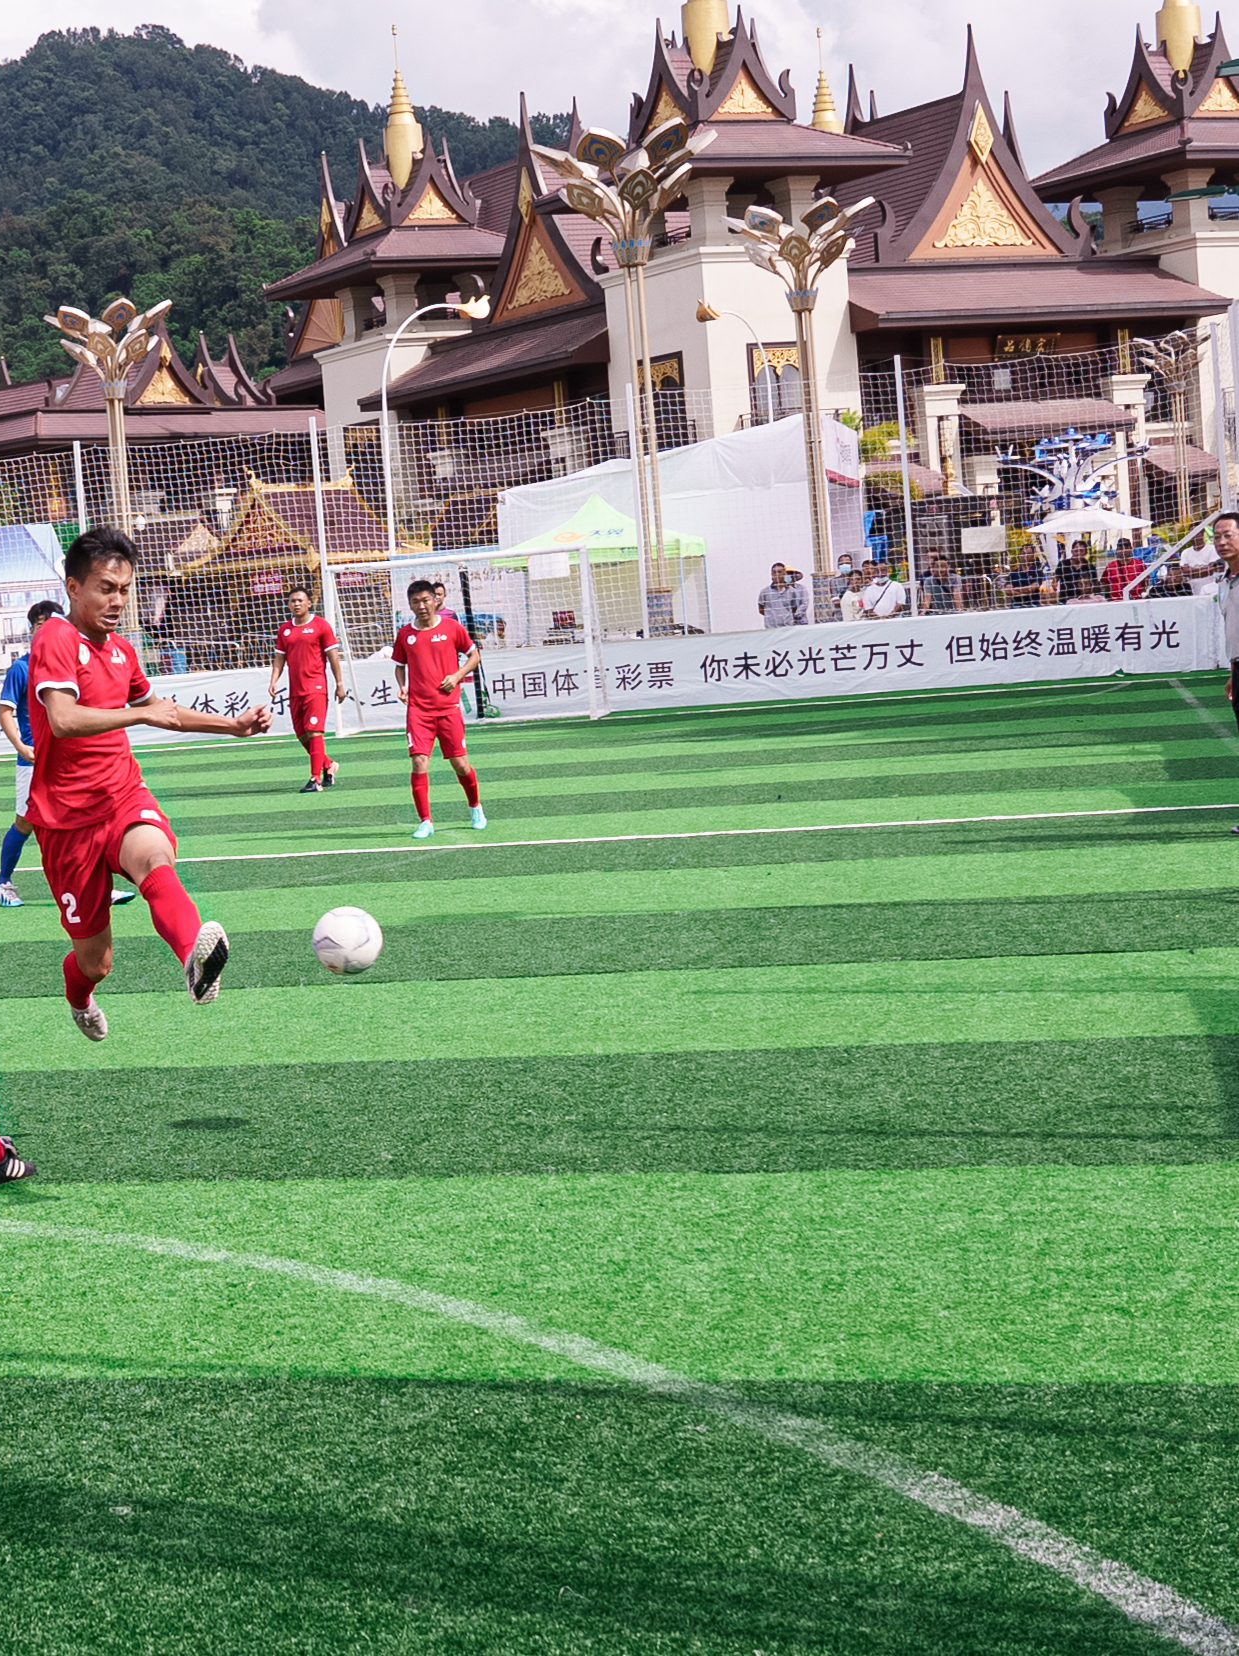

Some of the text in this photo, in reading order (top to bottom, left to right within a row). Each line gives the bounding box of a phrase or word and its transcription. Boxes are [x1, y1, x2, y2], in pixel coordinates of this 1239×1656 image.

[700, 638, 925, 683] 你未必光芒万丈
[945, 619, 1181, 665] 但始终温暖有光
[61, 892, 81, 924] 2
